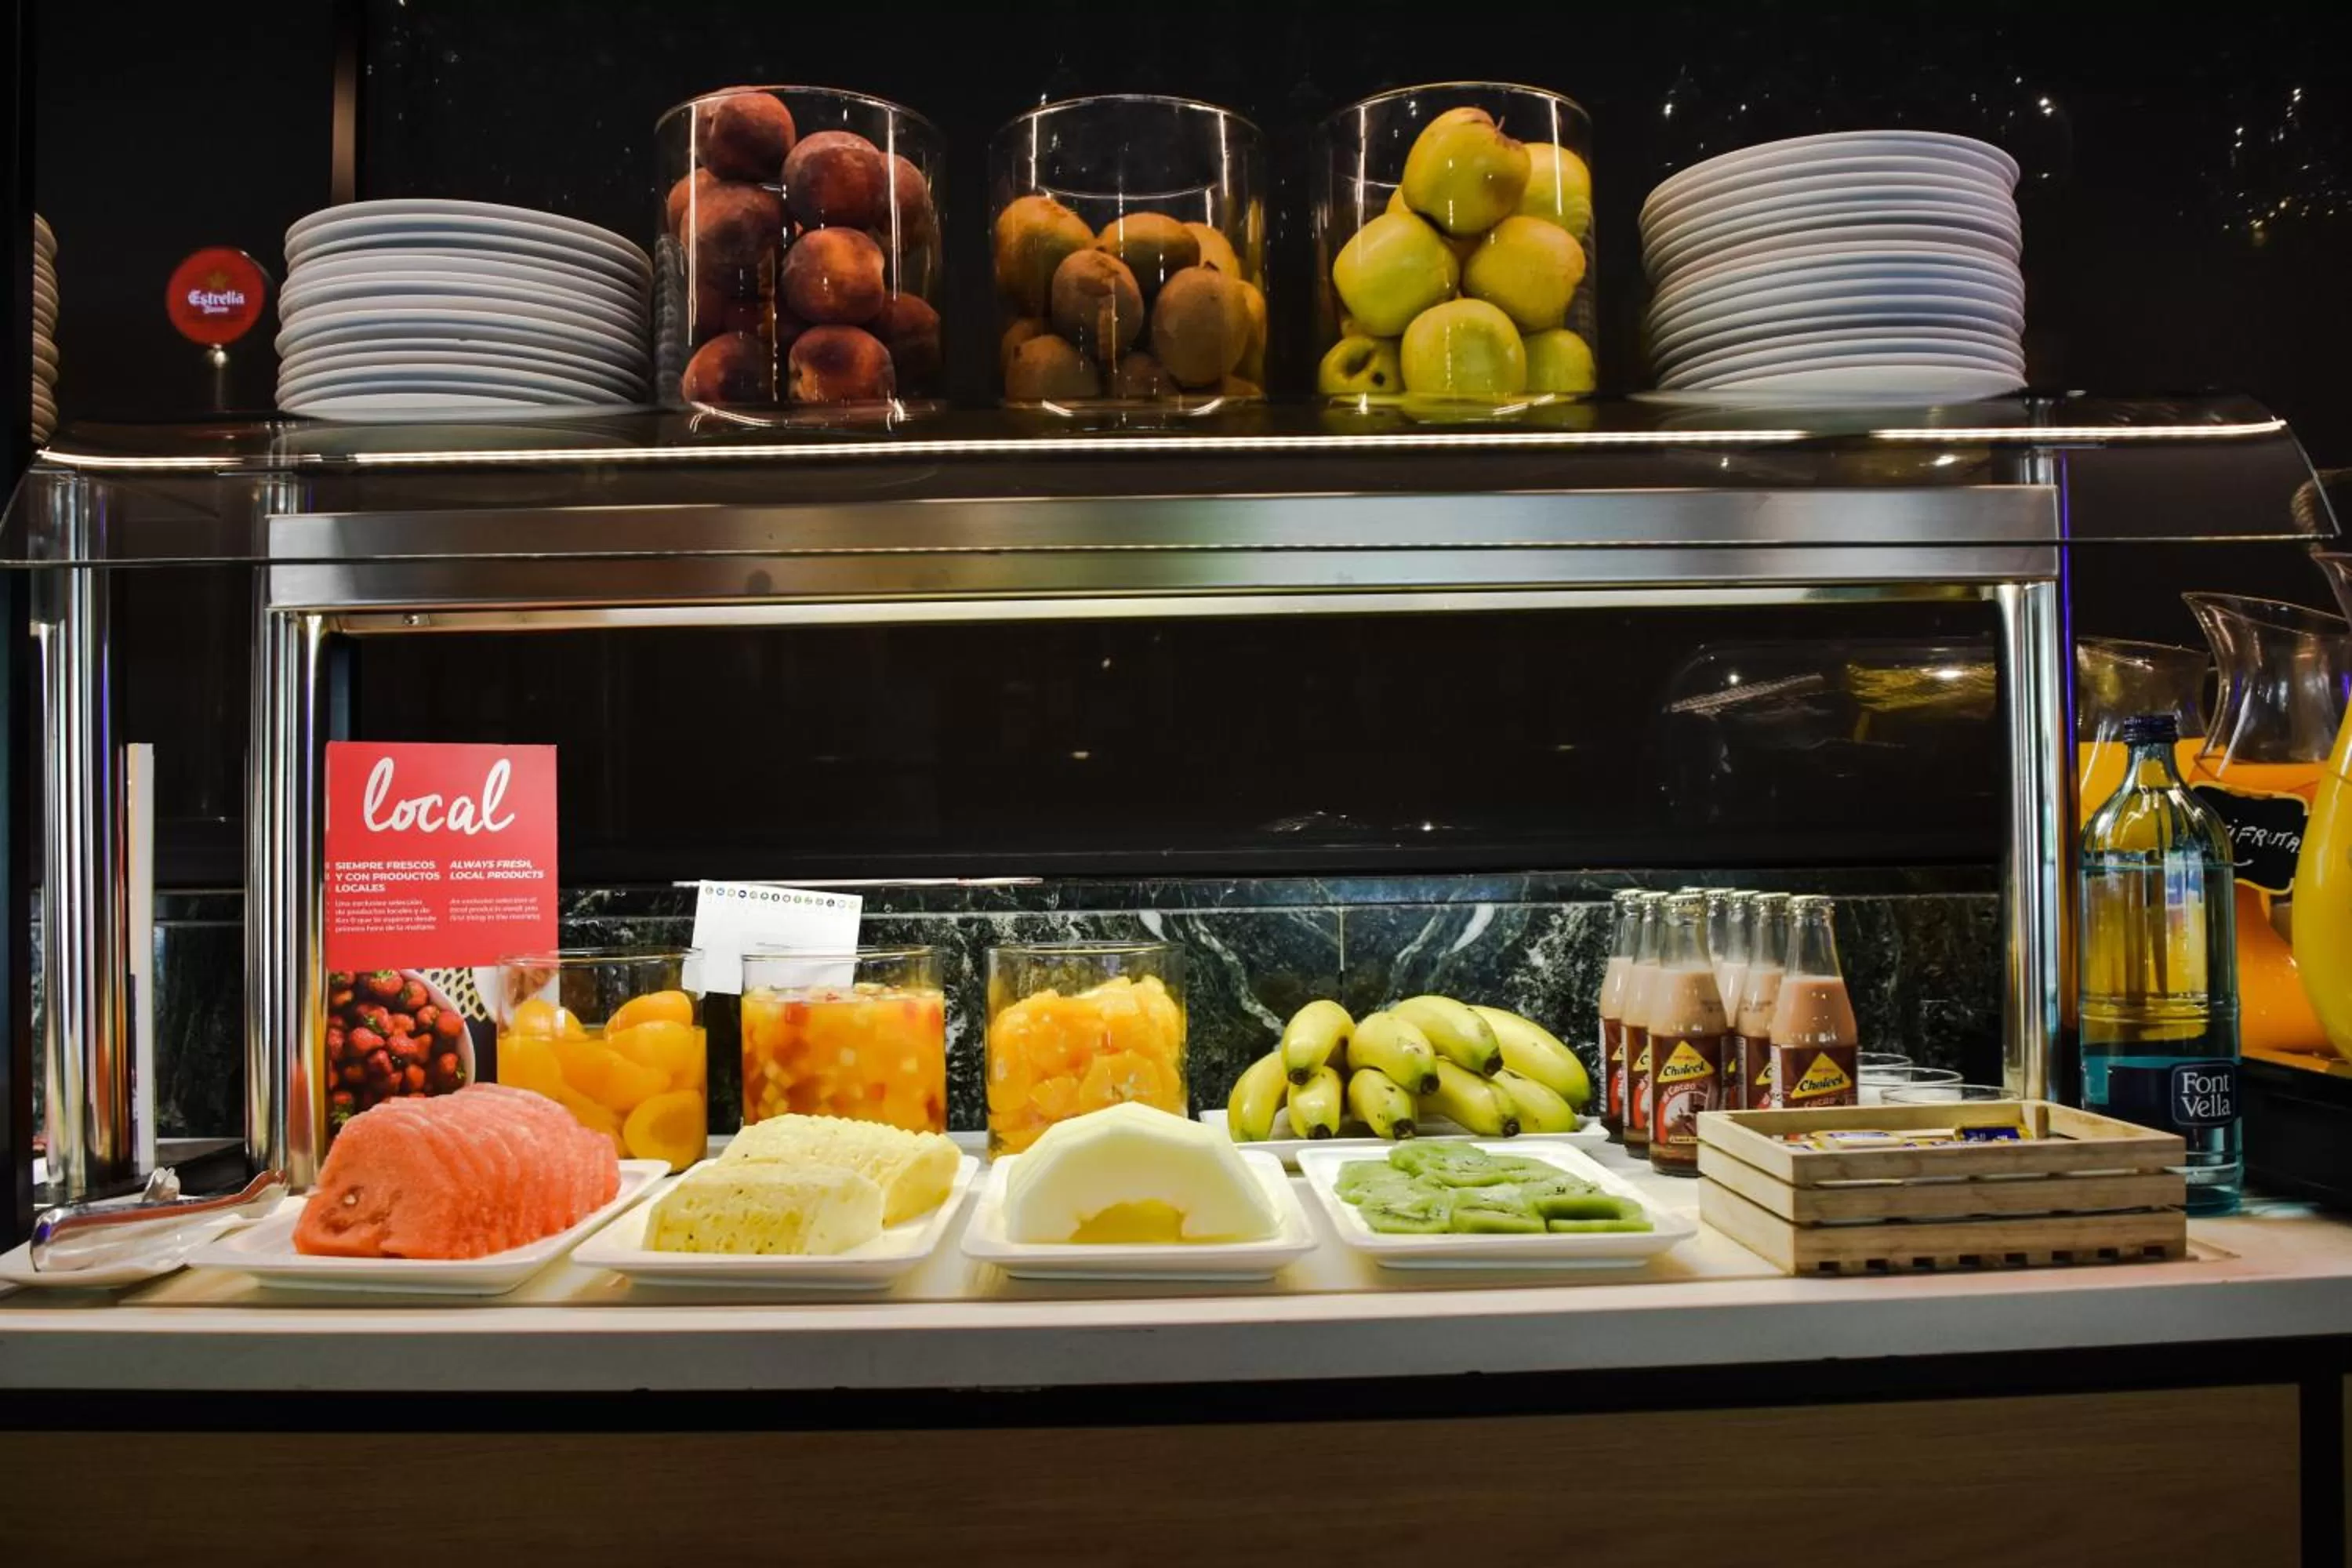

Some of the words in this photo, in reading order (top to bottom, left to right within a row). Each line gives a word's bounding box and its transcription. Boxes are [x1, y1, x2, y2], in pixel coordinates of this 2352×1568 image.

[188, 289, 245, 306] Estrella
[363, 757, 515, 835] local
[335, 862, 384, 870] SIEMPRE
[387, 861, 436, 869] FRESCOS
[449, 860, 495, 869] ALWAYS
[496, 859, 533, 869] FRESH,
[449, 871, 485, 880] LOCAL
[487, 870, 544, 879] PRODUCTS
[335, 884, 386, 893] LOCALES
[2181, 1072, 2230, 1094] Font
[2180, 1094, 2231, 1117] Vella
